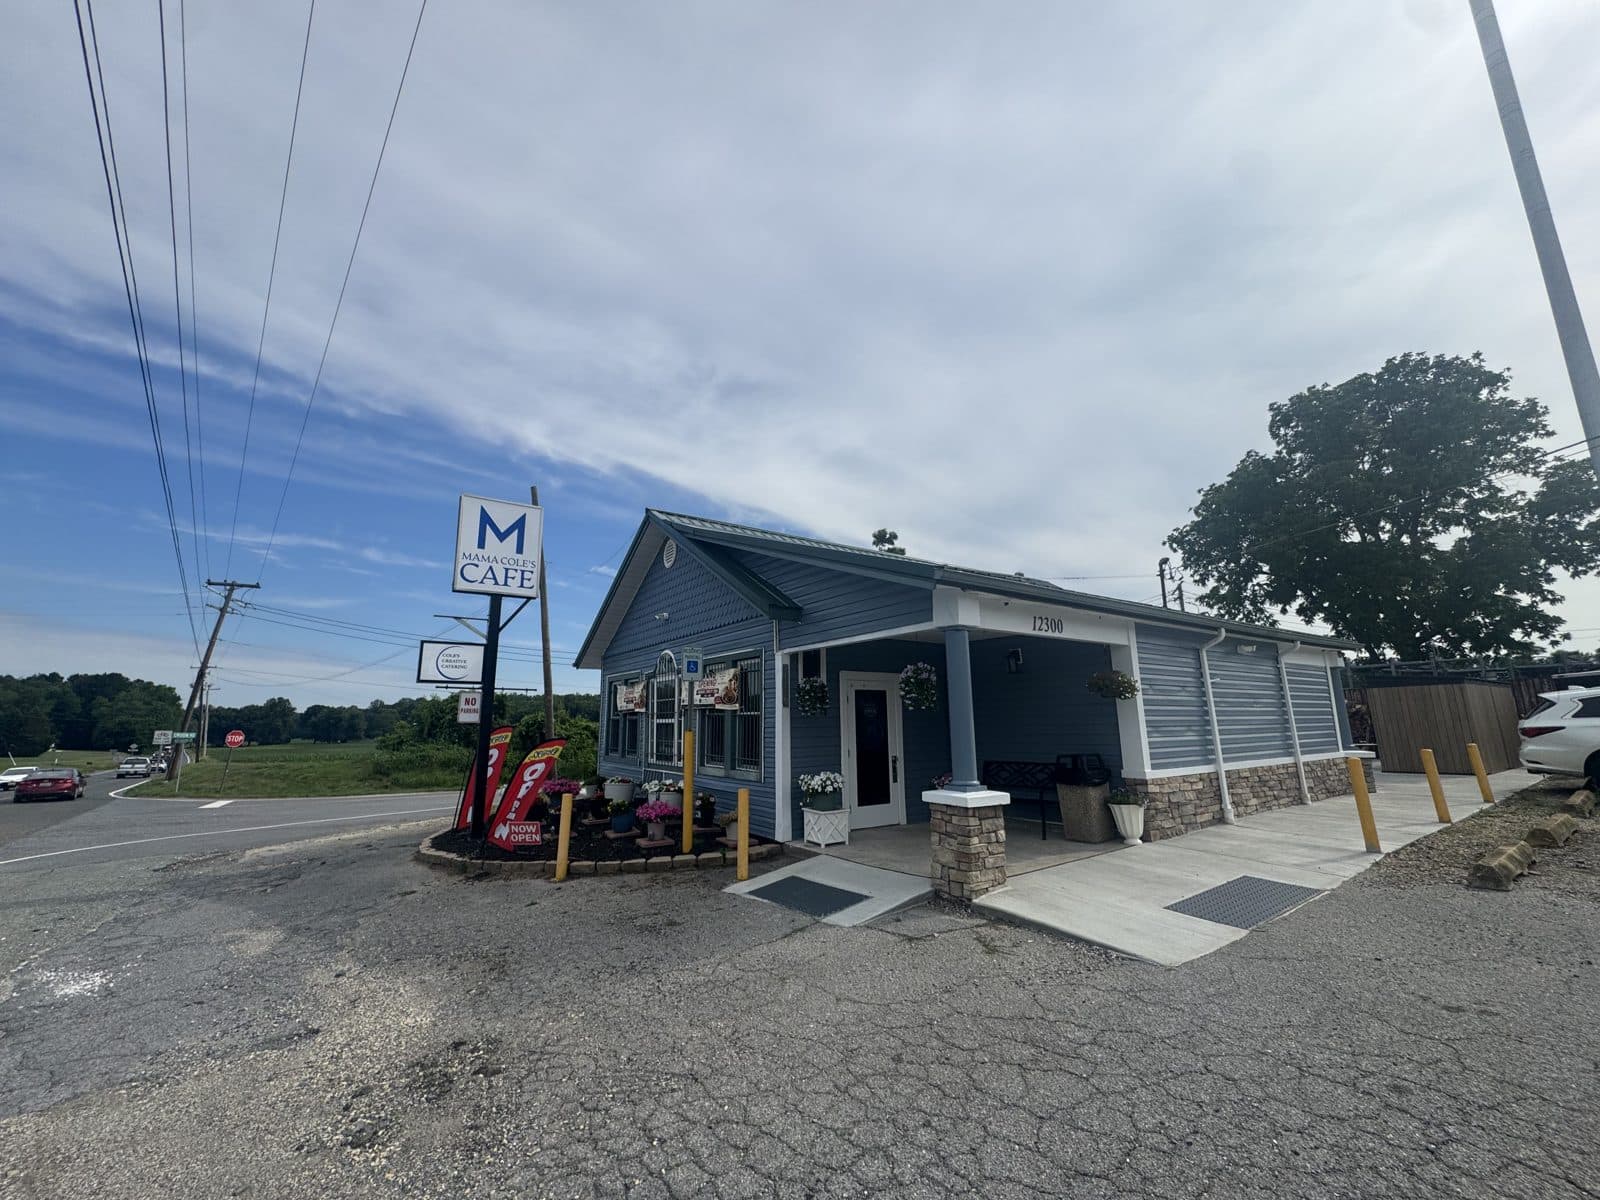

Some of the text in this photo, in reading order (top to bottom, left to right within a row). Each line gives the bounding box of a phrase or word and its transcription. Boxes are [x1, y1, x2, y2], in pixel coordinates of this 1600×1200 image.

[477, 505, 526, 555] M
[462, 551, 536, 569] MAMA COLE'S
[459, 562, 535, 590] CAFE
[1032, 616, 1063, 633] 12300
[464, 697, 476, 706] NO
[494, 762, 546, 841] OPEN
[511, 824, 537, 834] NOW
[511, 833, 540, 843] OPEN
